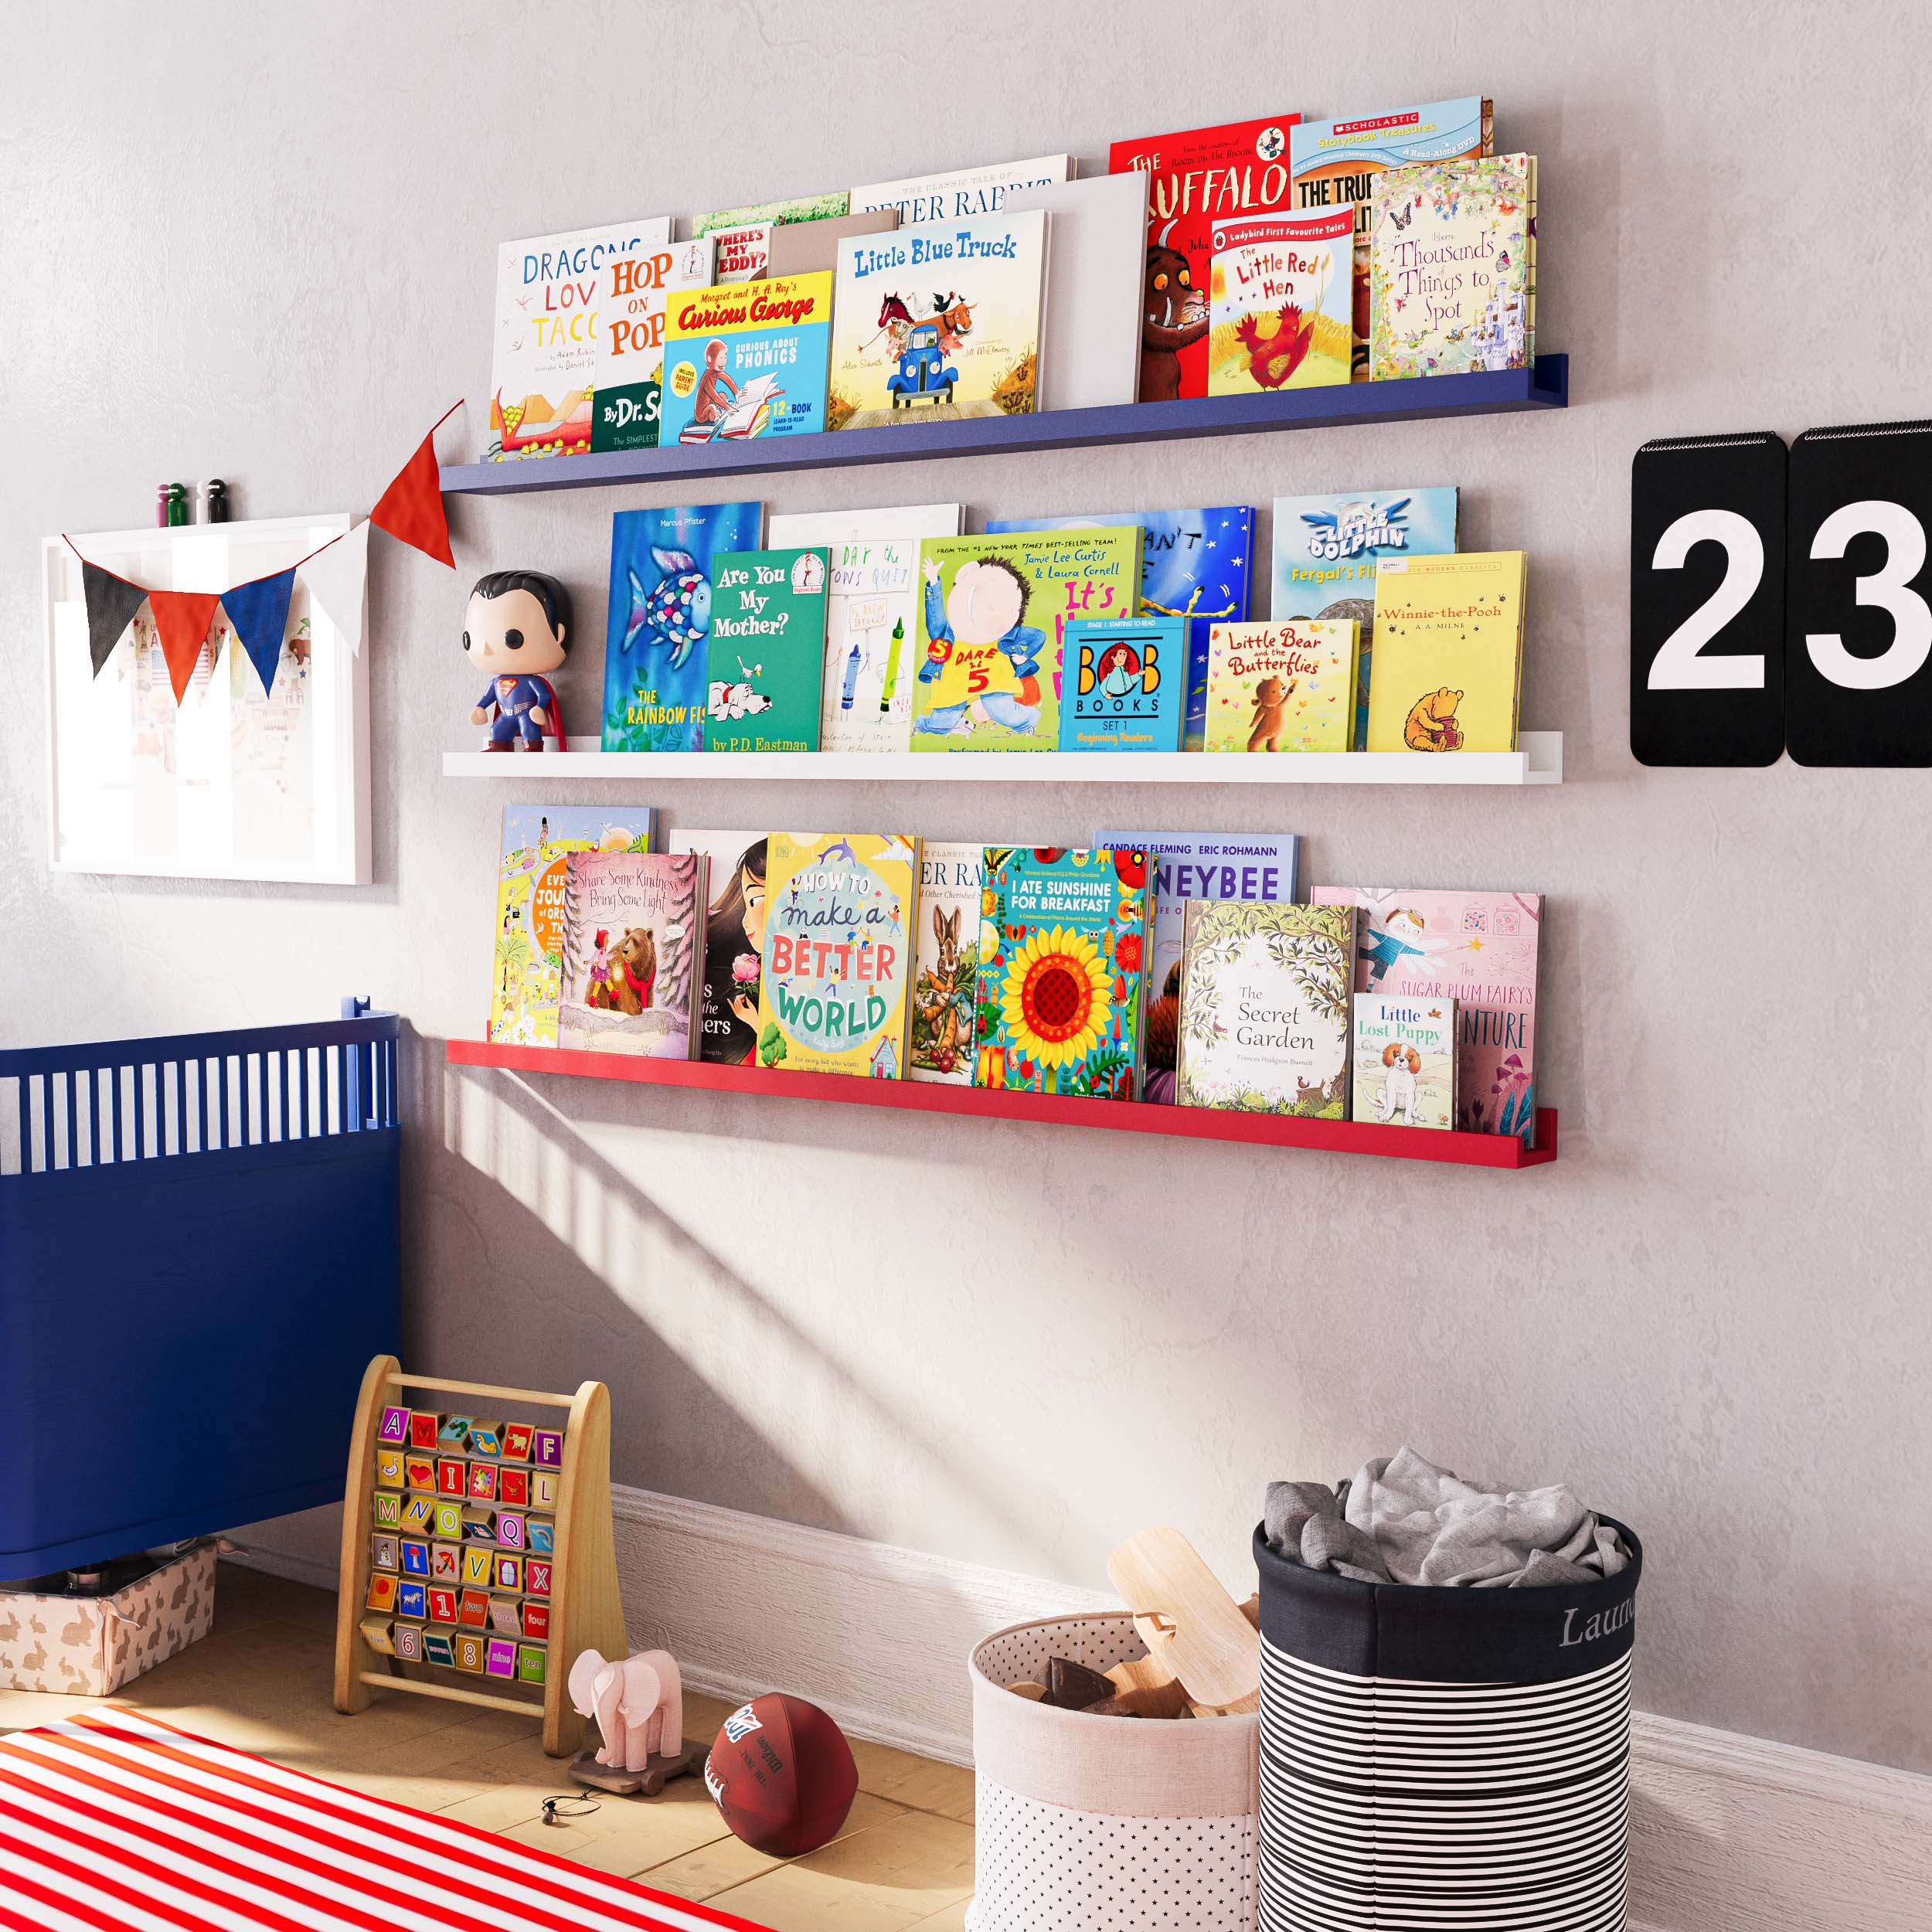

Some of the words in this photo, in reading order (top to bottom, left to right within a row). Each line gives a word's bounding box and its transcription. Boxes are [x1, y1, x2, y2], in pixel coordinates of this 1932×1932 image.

[1345, 114, 1417, 131] SCHOLASTIC
[1318, 132, 1377, 148] Storybook
[1380, 123, 1436, 139] Treasures
[1410, 143, 1458, 158] Read-Along
[1457, 136, 1475, 150] DVD
[1149, 163, 1287, 219] UFFALO
[1298, 179, 1330, 208] THE
[1230, 228, 1264, 241] Ladybird
[1266, 226, 1284, 236] First
[1286, 225, 1323, 236] Favourite
[1325, 223, 1345, 233] Tales
[726, 244, 748, 257] MY
[854, 247, 906, 278] Little
[911, 238, 953, 265] Blue
[957, 231, 1017, 258] Truck
[1188, 239, 1209, 253] Julia
[1240, 247, 1256, 259] The
[1394, 232, 1495, 267] Thousands
[524, 238, 641, 284] DRAGO
[1236, 253, 1282, 284] Little
[1288, 252, 1318, 275] Red
[611, 253, 673, 298] HOP
[1398, 267, 1462, 300] Things
[1472, 270, 1489, 287] to
[733, 289, 748, 298] and
[753, 286, 760, 296] H.
[1263, 279, 1294, 300] Hen
[628, 297, 649, 314] ON
[679, 304, 747, 331] Curious
[750, 295, 815, 325] George
[1424, 295, 1462, 331] Spot
[577, 348, 594, 357] Rubin
[736, 342, 769, 352] CURIOUS
[773, 337, 798, 348] ABOUT
[566, 359, 583, 370] Daniel
[736, 347, 797, 369] PHONICS
[676, 382, 690, 392] GUIDE
[604, 407, 617, 423] By
[616, 398, 642, 427] Dr.
[774, 417, 804, 425] LEARN-TO-READ
[627, 434, 658, 444] SIMPLEST
[660, 519, 682, 528] Marcus
[1327, 511, 1388, 542] LITTLE
[1046, 539, 1091, 549] BEST-SELLING
[1311, 528, 1405, 560] DOLPHIN
[843, 546, 871, 567] DAY
[1024, 553, 1049, 565] Jamie
[1053, 551, 1070, 563] Lee
[1074, 549, 1107, 561] Curtis
[717, 568, 749, 589] Are
[753, 566, 785, 584] You
[872, 567, 908, 591] QUIT
[1048, 566, 1079, 578] Laura
[1083, 562, 1120, 577] Cornell
[1291, 567, 1352, 585] Fergal's
[739, 590, 770, 614] My
[1065, 580, 1114, 611] It's
[1384, 605, 1502, 621] Winnie-the-Pooh
[713, 613, 789, 638] Mother?
[1228, 631, 1276, 650] Little
[1280, 628, 1321, 648] Bear
[955, 648, 998, 665] DARE
[1228, 651, 1319, 676] Butterflies
[968, 668, 989, 692] 5
[1078, 641, 1162, 697] BOB
[638, 690, 657, 704] THE
[628, 706, 688, 724] RAINBOW
[1103, 721, 1119, 730] SET
[755, 737, 808, 751] Eastman
[1077, 733, 1117, 746] Beginning
[1120, 732, 1153, 743] Readers
[1150, 845, 1192, 854] FLEMING
[1223, 845, 1277, 856] ROHMANN
[546, 875, 565, 886] EVE
[579, 869, 606, 888] Share
[609, 868, 634, 888] Some
[637, 868, 679, 892] Kindness
[803, 871, 846, 894] HOW
[849, 873, 871, 895] TO
[1019, 879, 1043, 894] ATE
[1046, 881, 1111, 896] SUNSHINE
[590, 889, 616, 913] Bring
[618, 887, 641, 906] Some
[643, 889, 668, 918] Light
[944, 890, 975, 900] Cherished
[1012, 896, 1036, 909] FOR
[1041, 897, 1111, 912] BREAKFAST
[781, 896, 862, 927] make
[772, 934, 896, 981] BETTER
[1240, 986, 1263, 999] The
[1400, 980, 1441, 998] SUGAR
[1447, 983, 1481, 1002] PLUM
[1487, 985, 1533, 1005] FAIRY'S
[777, 985, 886, 1037] WORLD
[1238, 1002, 1301, 1024] Secret
[1380, 1005, 1421, 1023] Little
[1237, 1026, 1315, 1049] Garden
[1359, 1020, 1390, 1037] Lost
[1396, 1022, 1442, 1046] Puppy
[437, 1594, 451, 1617] 1
[464, 1600, 483, 1614] two
[402, 1632, 415, 1655] 6
[464, 1643, 477, 1666] 8
[525, 1658, 541, 1670] ten
[757, 1736, 784, 1774] Wilson
